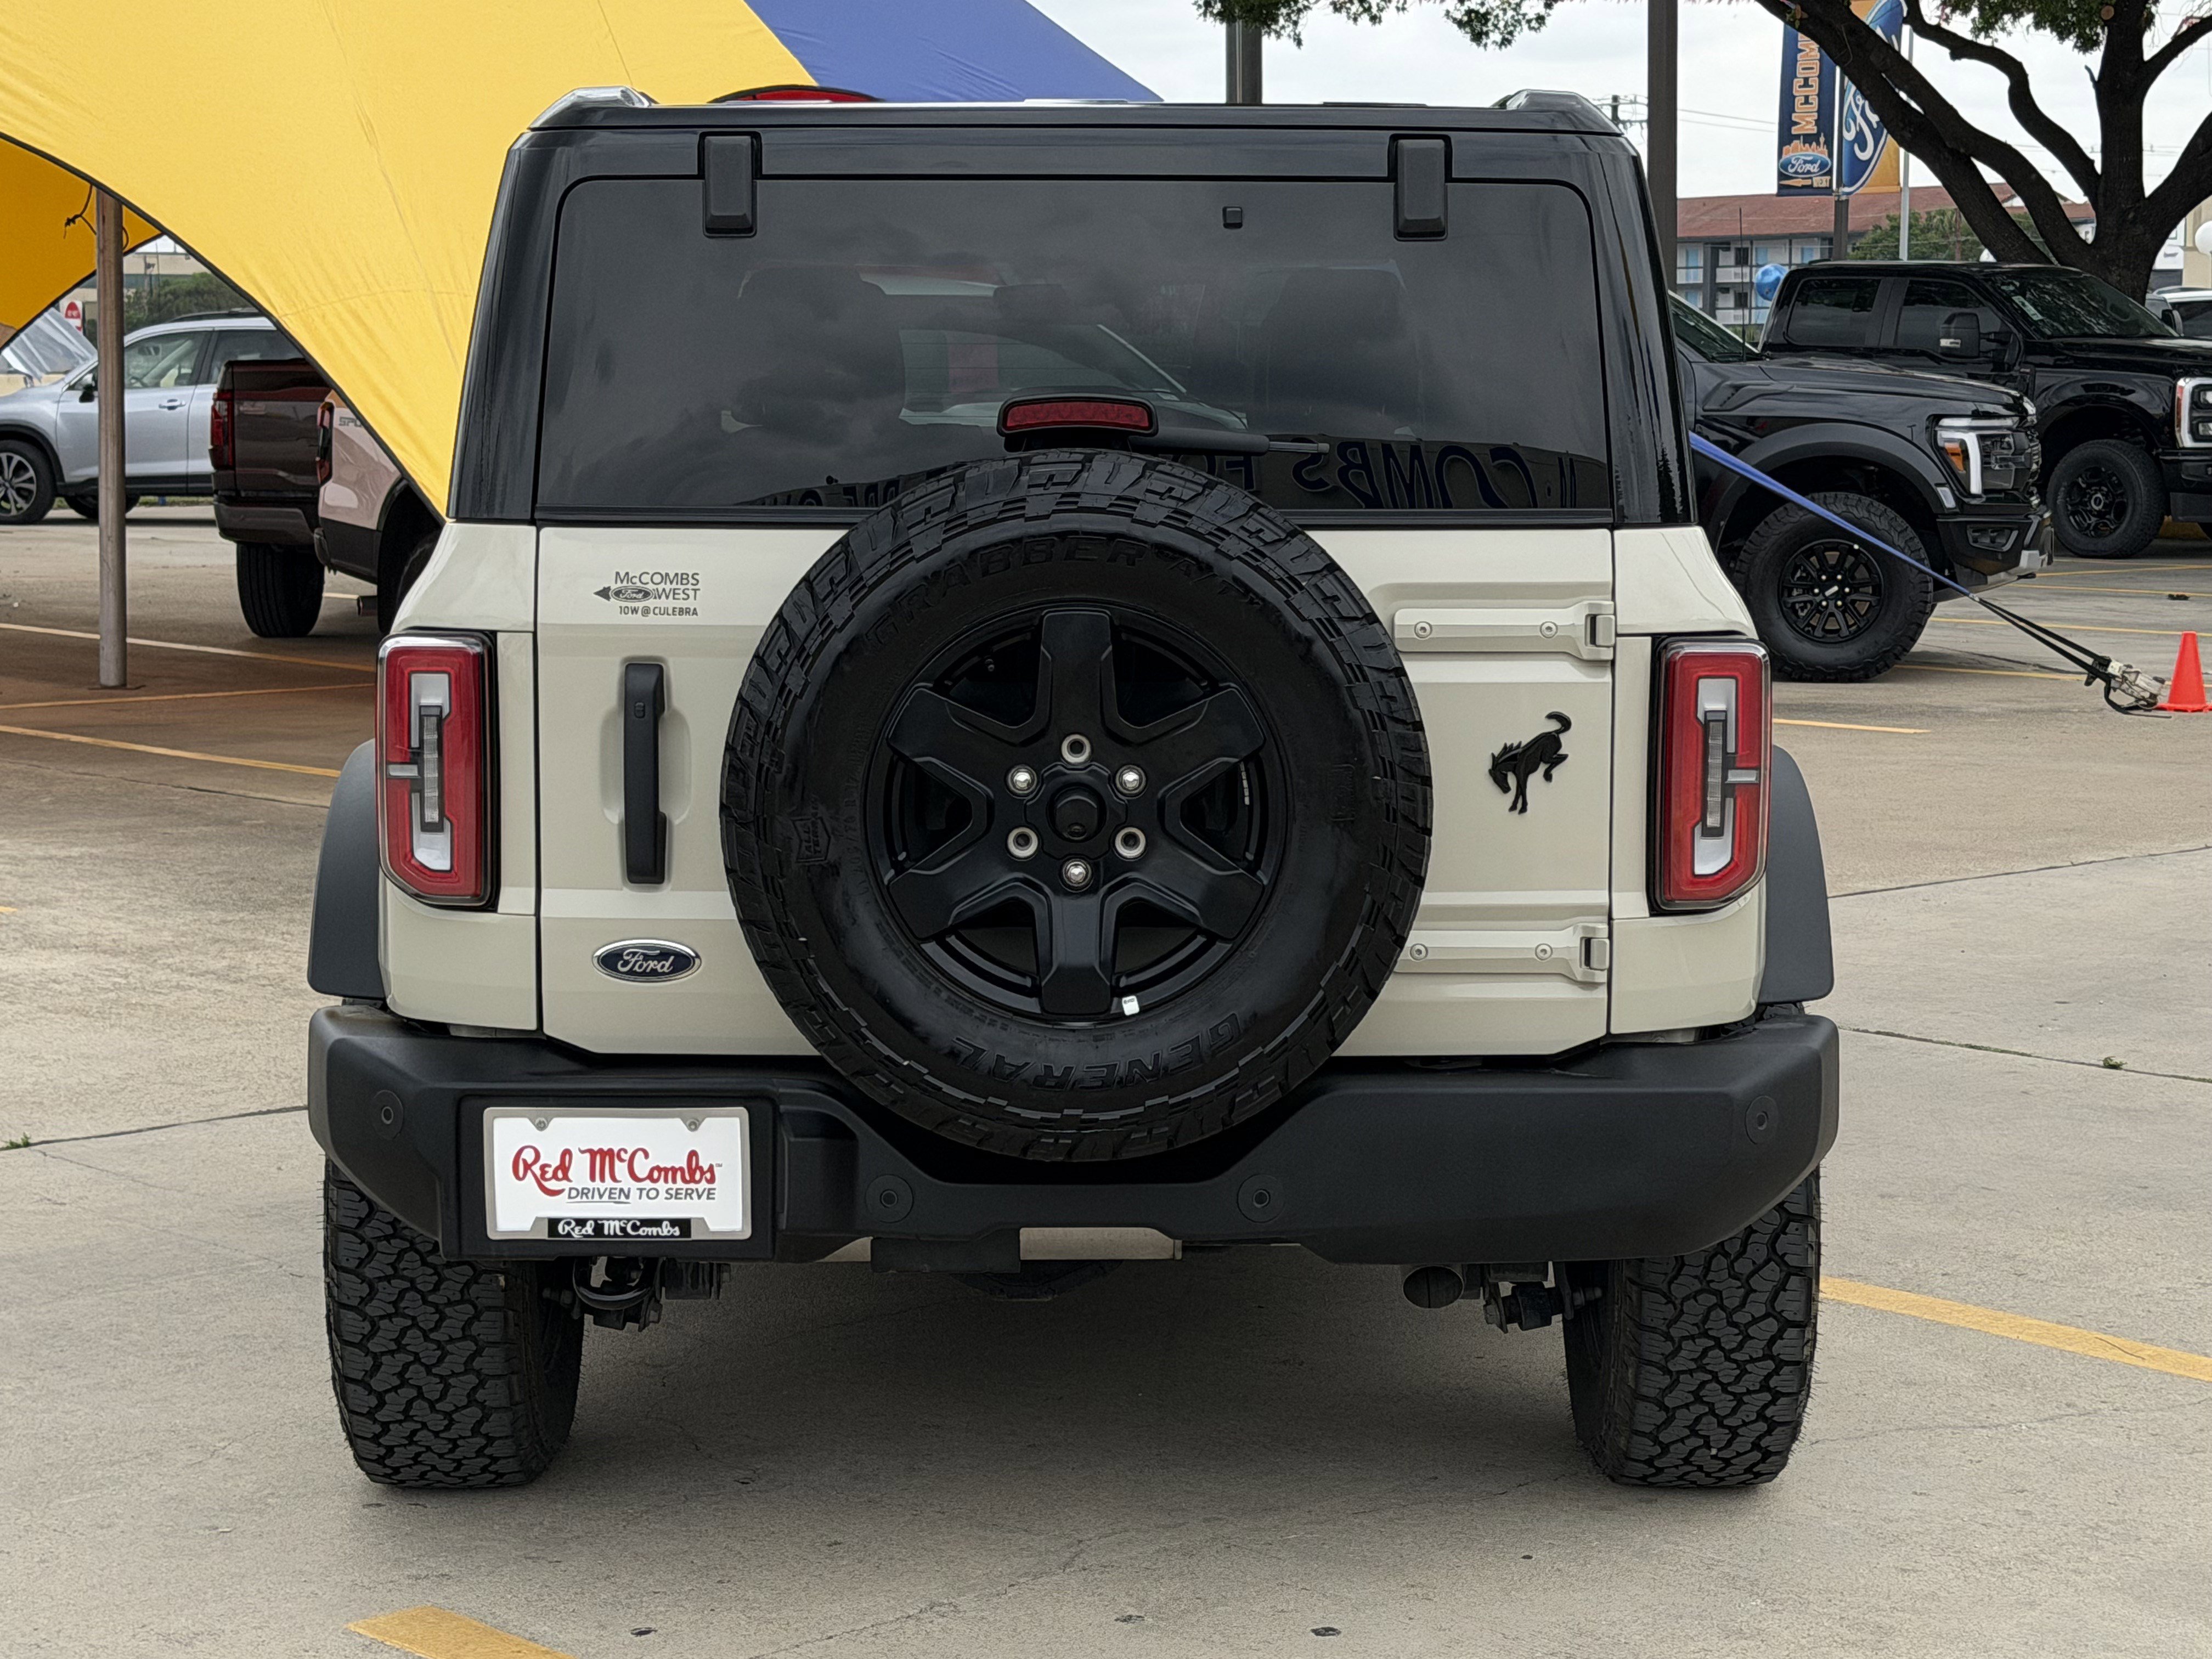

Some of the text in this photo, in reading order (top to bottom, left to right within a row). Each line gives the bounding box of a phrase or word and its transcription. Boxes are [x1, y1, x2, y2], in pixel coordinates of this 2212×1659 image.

[1788, 156, 1821, 173] Ford
[614, 571, 700, 586] McCOMBS
[656, 588, 701, 601] WEST
[652, 606, 699, 617] CULEBRA
[617, 949, 675, 973] Ford
[949, 1012, 1241, 1093] GENERAL
[512, 1145, 573, 1197] Red
[567, 1187, 716, 1200] DRIVEN TO SERVE
[558, 1219, 680, 1238] Red McCombs
